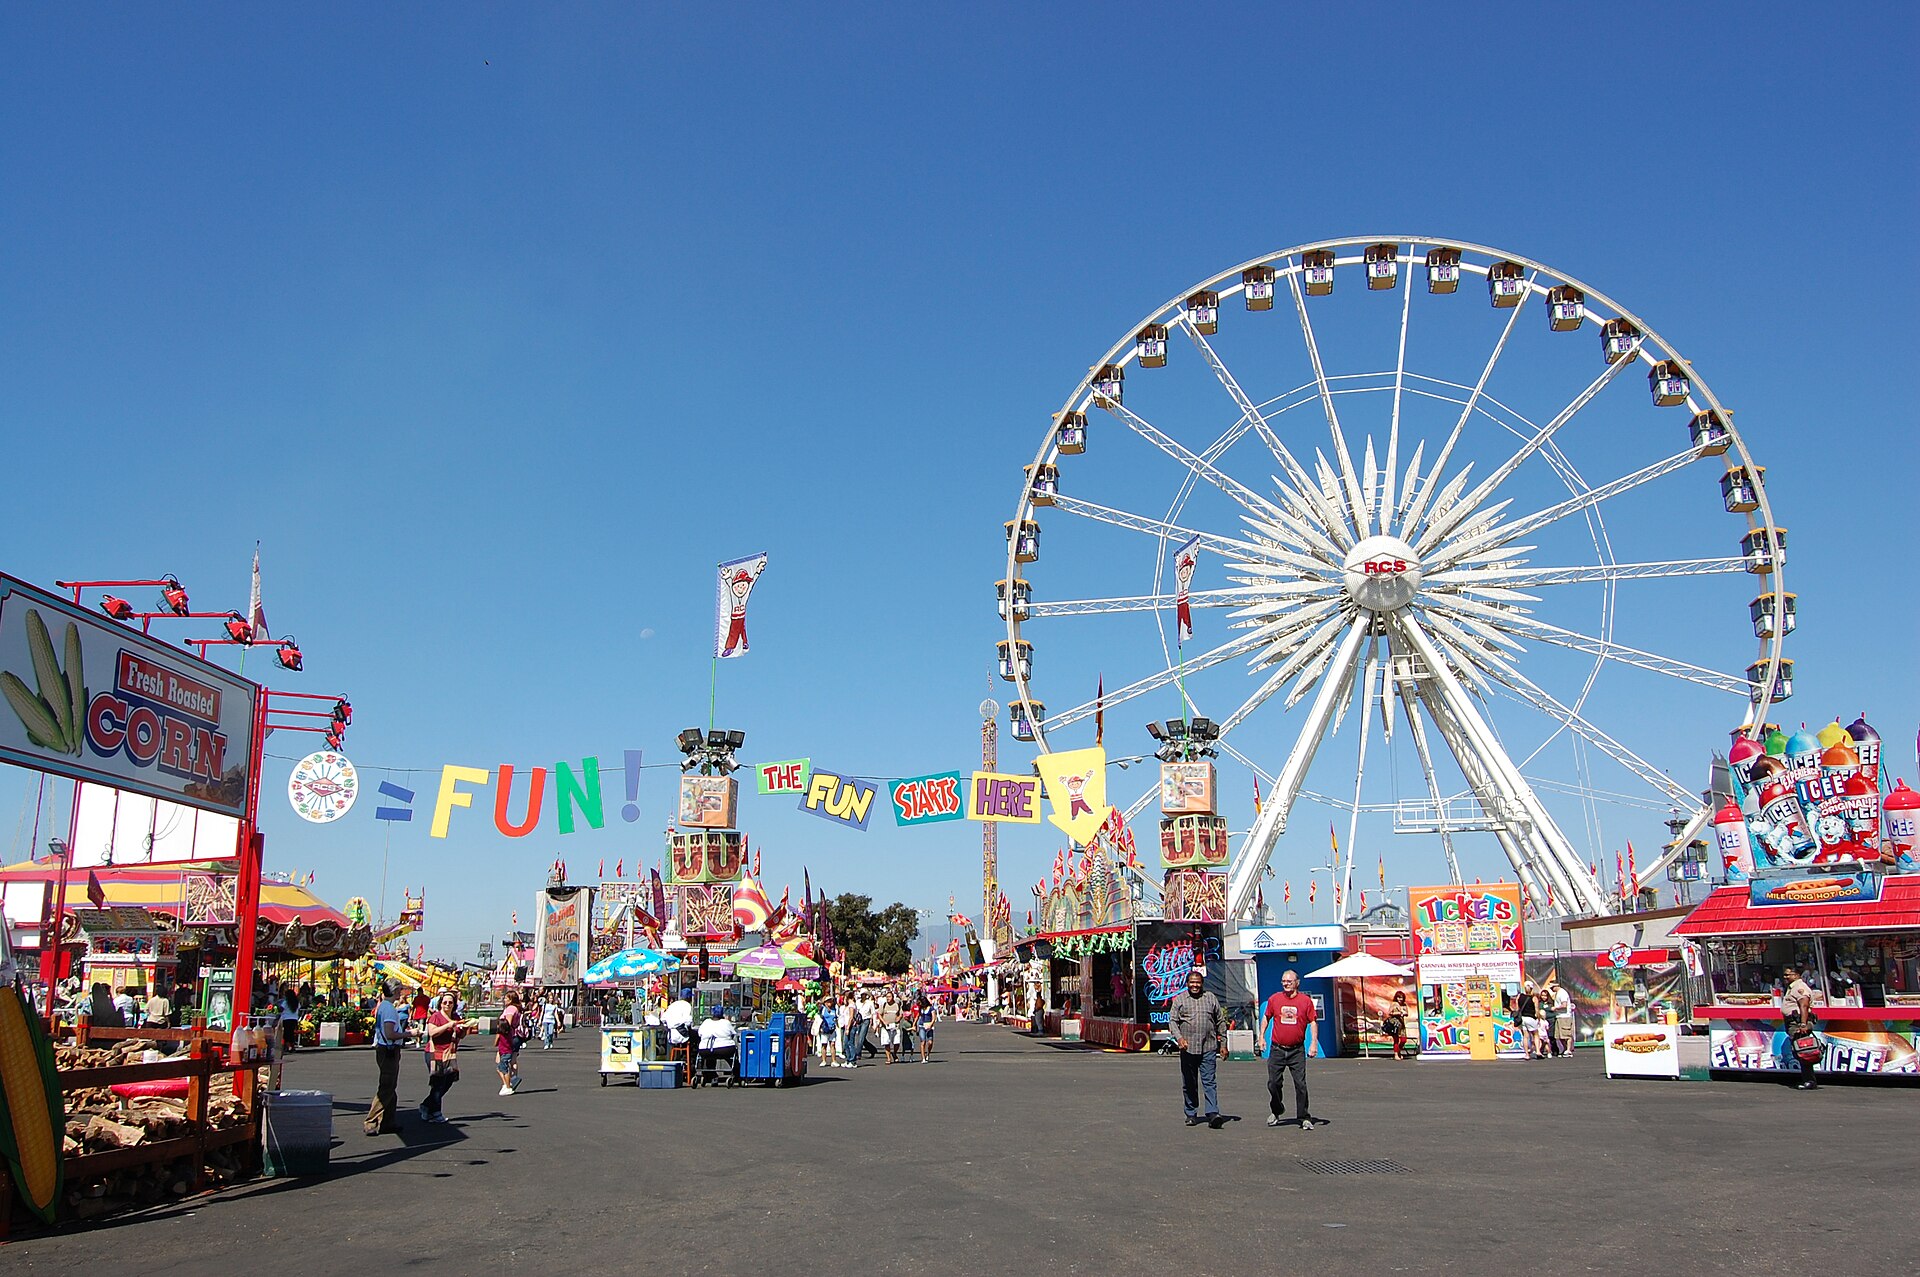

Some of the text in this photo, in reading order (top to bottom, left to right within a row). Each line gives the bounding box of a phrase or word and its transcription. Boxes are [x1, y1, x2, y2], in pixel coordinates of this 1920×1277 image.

[1364, 560, 1407, 573] RCS
[127, 661, 214, 717] Fresh Roasted
[87, 693, 229, 781] CORN
[763, 764, 1035, 824] THE FUN STARTS HERE
[1800, 774, 1845, 801] ICEE
[1818, 795, 1839, 809] THE
[1821, 798, 1872, 816] ORIGINAL!
[1766, 887, 1860, 901] MILE LONG HOT DOG
[1417, 893, 1513, 923] TICKETS
[1305, 937, 1328, 946] ATM
[213, 971, 233, 980] ATM
[1437, 1023, 1513, 1045] TICTS
[1625, 1044, 1641, 1052] LONG
[1826, 1043, 1883, 1072] ICEE
